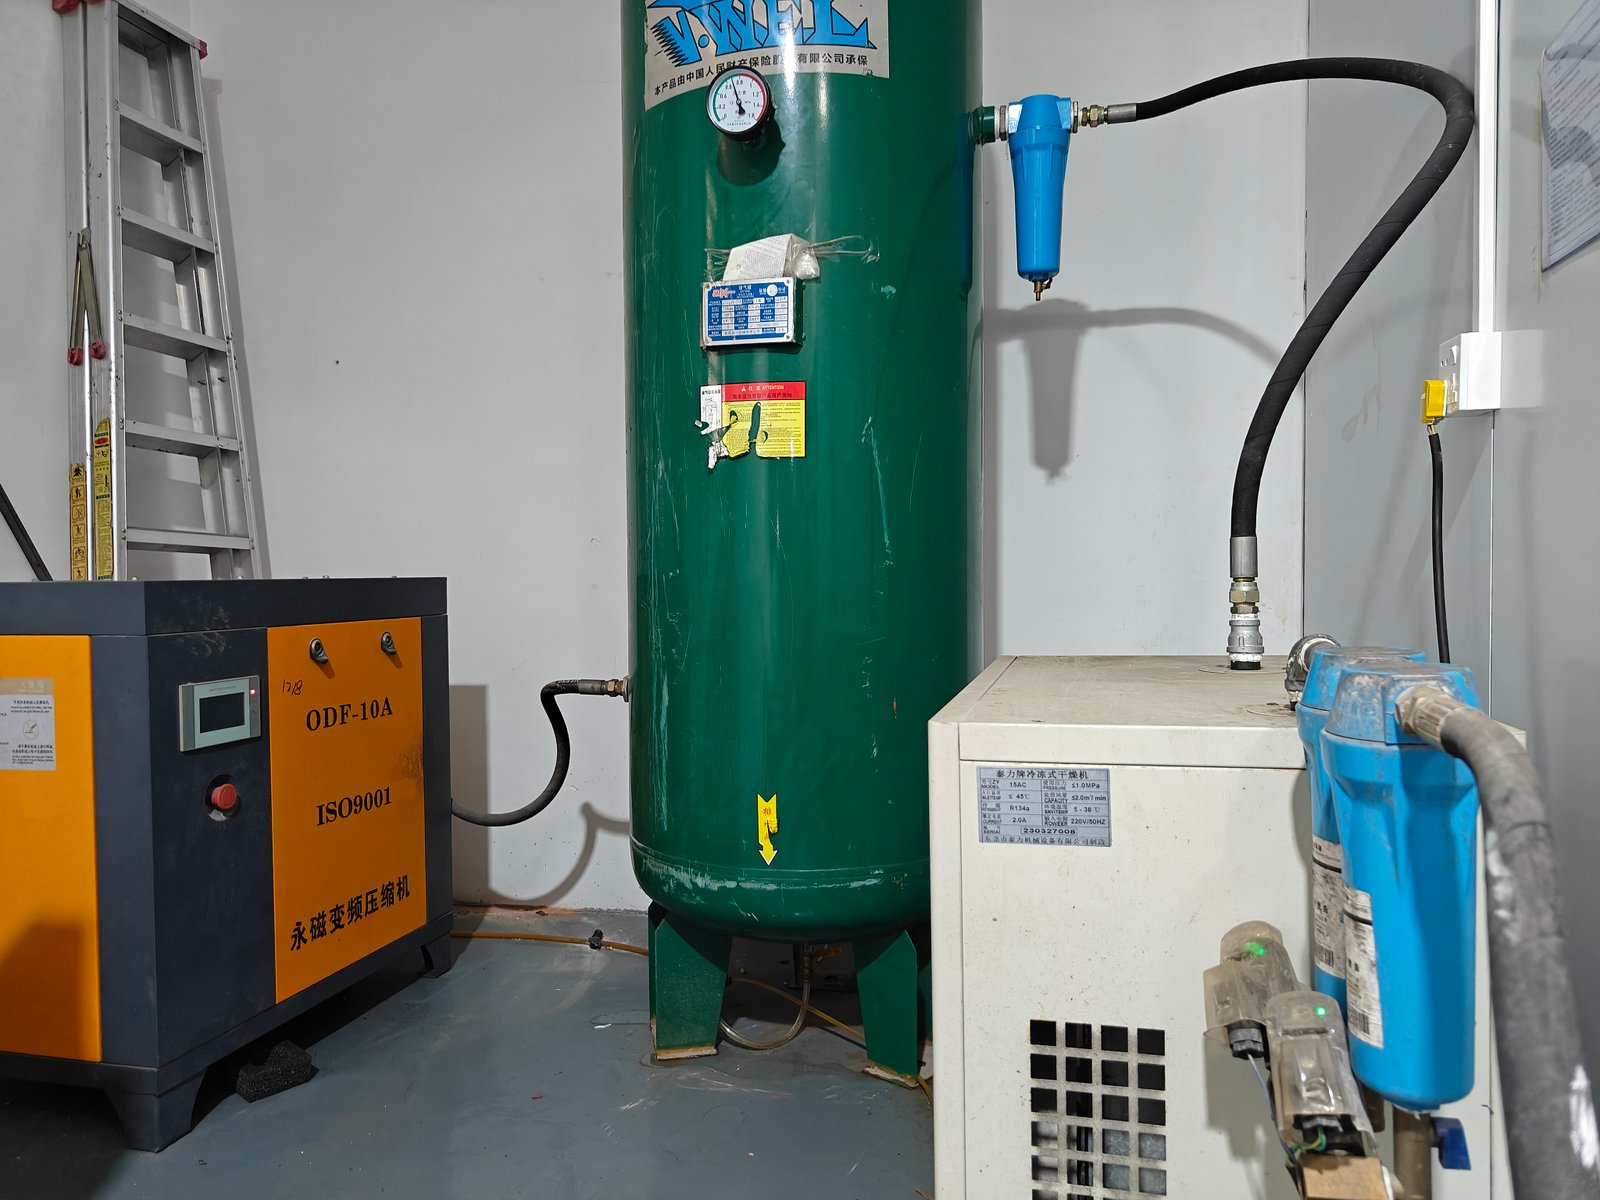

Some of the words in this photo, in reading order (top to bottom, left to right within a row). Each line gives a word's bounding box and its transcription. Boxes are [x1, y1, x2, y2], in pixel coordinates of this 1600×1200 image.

[654, 52, 868, 96] 本产品由中国人民财产保险股有限公司承保
[306, 696, 393, 732] ODF-10A
[996, 769, 1089, 780] 泰力牌冷冻式干燥机
[316, 786, 392, 827] ISO9001
[1009, 804, 1030, 812] R134a
[290, 874, 411, 952] 永磁变频压缩机
